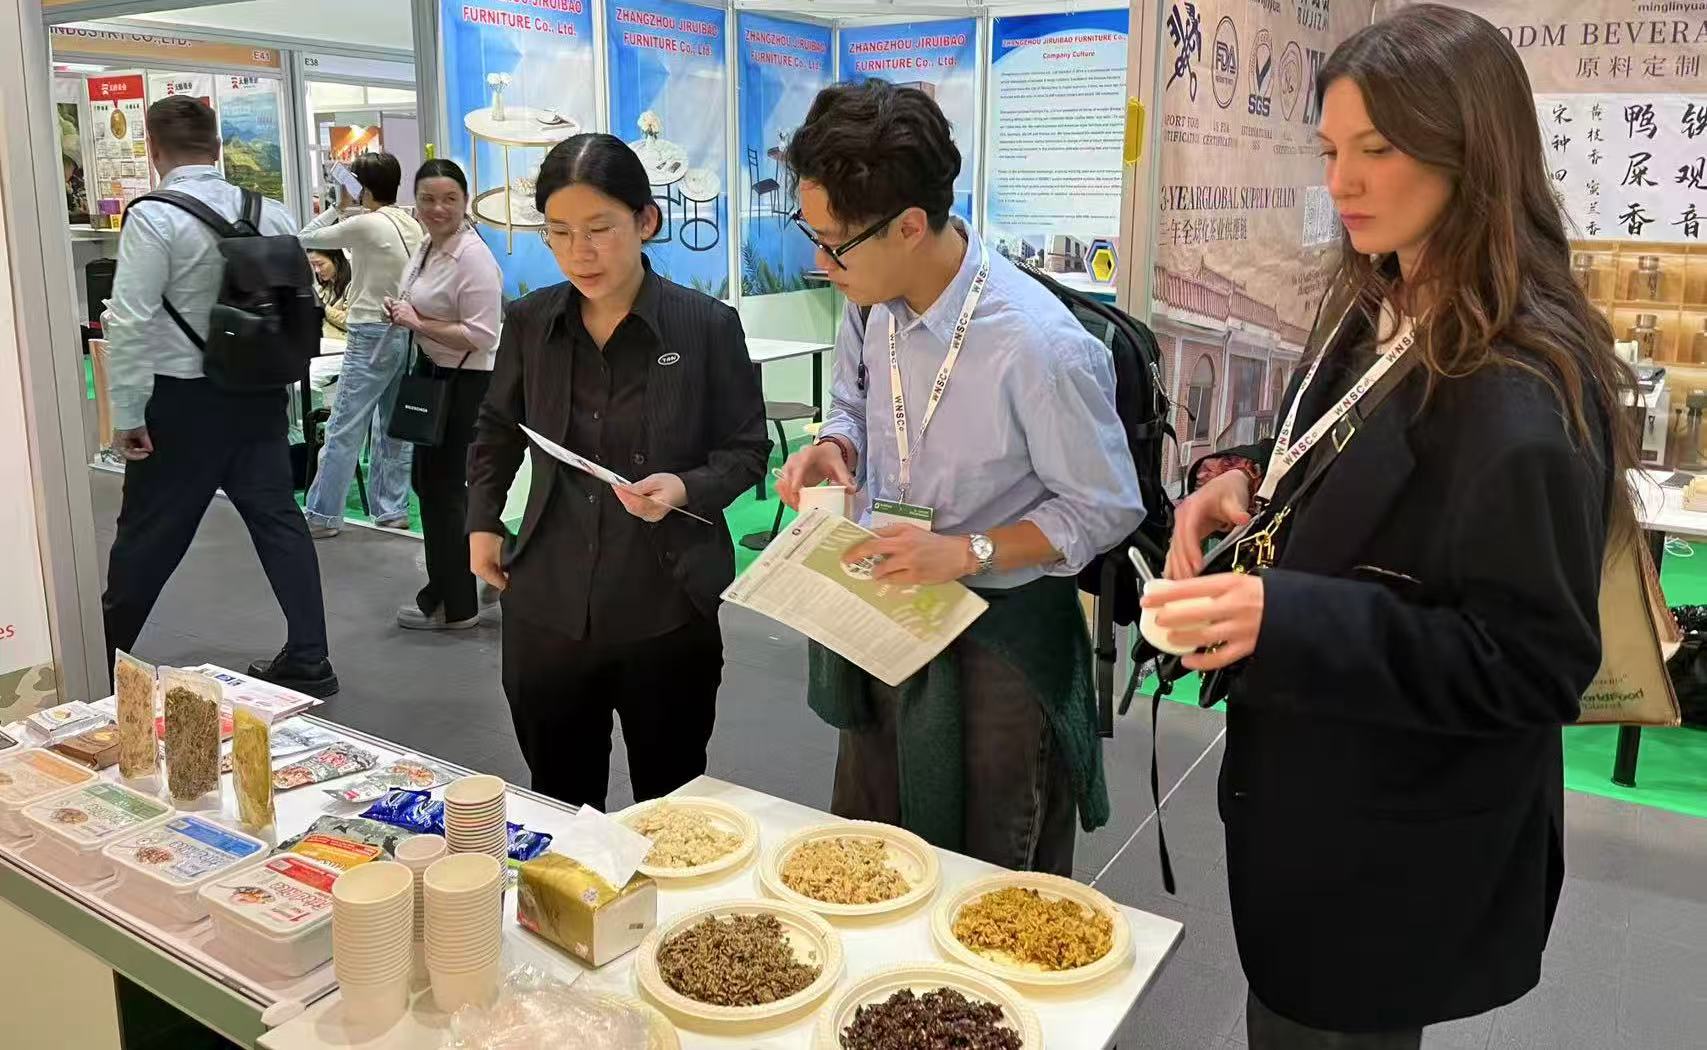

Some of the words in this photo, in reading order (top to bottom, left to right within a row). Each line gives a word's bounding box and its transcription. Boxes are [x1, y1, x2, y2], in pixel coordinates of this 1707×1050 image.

[463, 6, 532, 29] FURNITURE
[616, 8, 676, 29] ZHANGZHOU
[678, 20, 719, 37] JIRUIBAO
[623, 32, 678, 51] FURNITURE
[745, 30, 791, 46] ZHANGZHOU
[849, 39, 913, 53] ZHANGZHOU
[915, 34, 966, 48] JIRUIBAO
[1042, 35, 1074, 45] JIRUIBAO
[1074, 33, 1112, 43] FURNITURE
[751, 50, 793, 66] FURNITURE
[1042, 51, 1071, 60] Company
[1072, 49, 1096, 58] Culture
[855, 57, 913, 72] FURNITURE
[1576, 54, 1700, 78] 原料定制
[1248, 94, 1272, 117] SGS
[1618, 103, 1659, 237] 鸭屎香
[1240, 186, 1271, 209] SUPPLY
